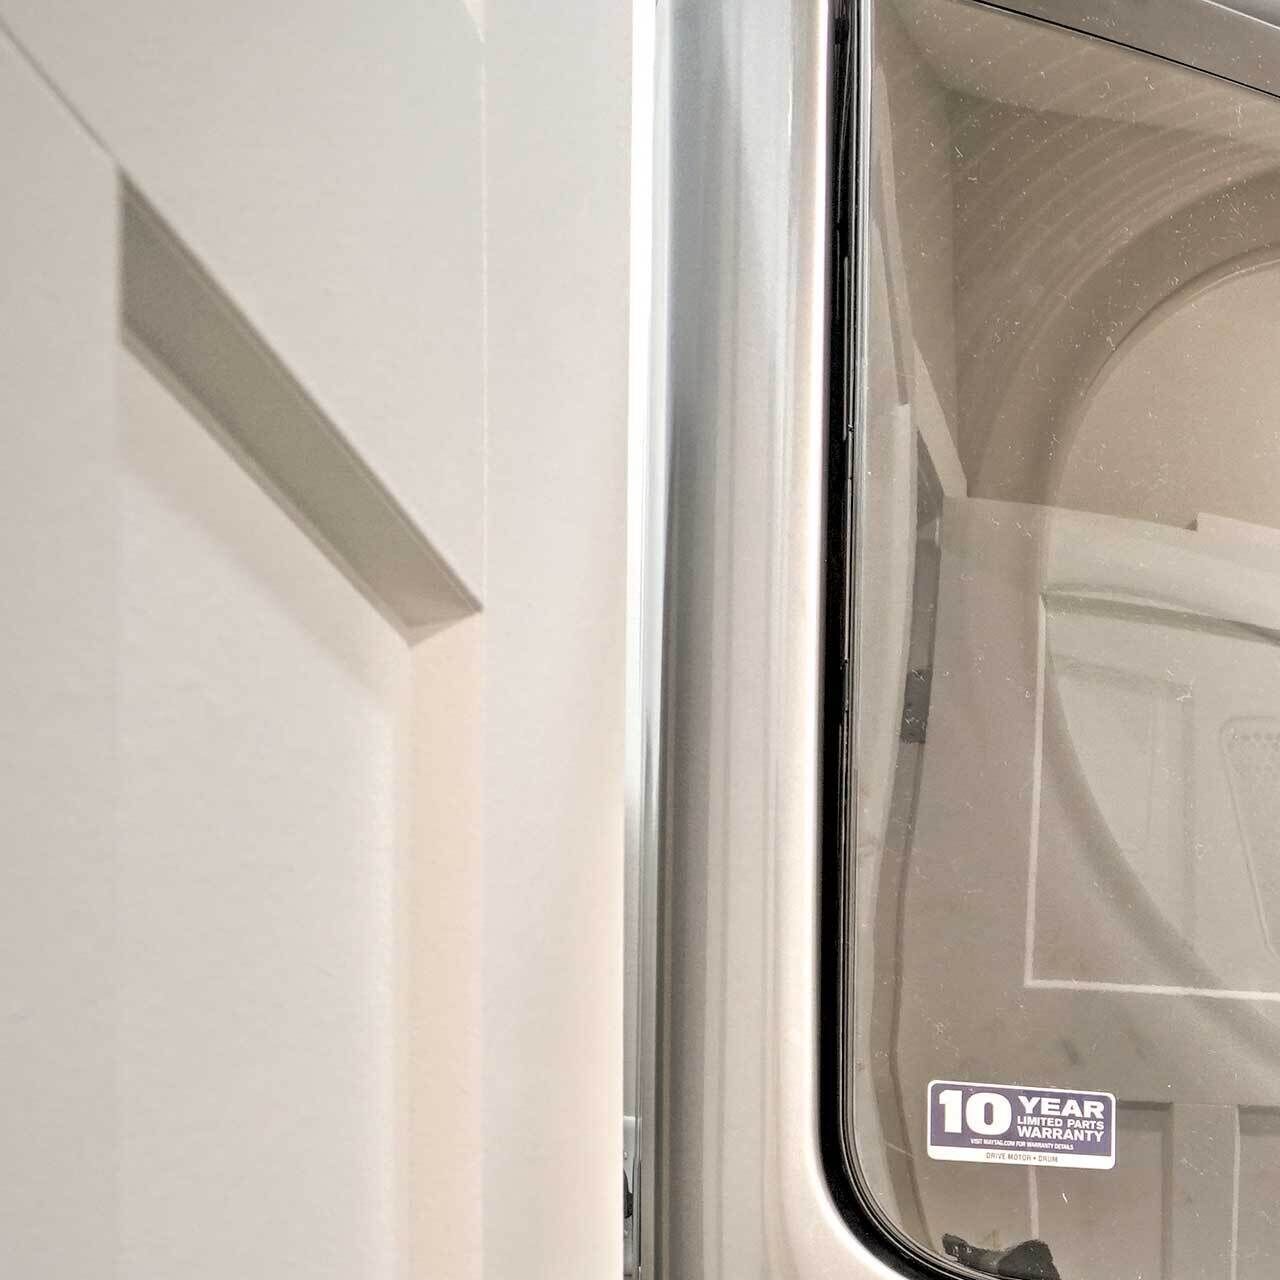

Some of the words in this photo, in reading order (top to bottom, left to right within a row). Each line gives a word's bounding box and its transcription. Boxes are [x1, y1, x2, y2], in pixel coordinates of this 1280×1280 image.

[939, 1089, 1012, 1135] 10
[1017, 1095, 1105, 1119] YEAR
[1017, 1116, 1062, 1128] LIMITED
[1067, 1118, 1105, 1130] PARTS
[1017, 1125, 1105, 1143] WARRANTY
[1026, 1141, 1054, 1149] WARRANTY
[986, 1152, 1006, 1160] DRIVE
[1008, 1153, 1032, 1161] MOTOR
[1038, 1154, 1058, 1163] DRUM
